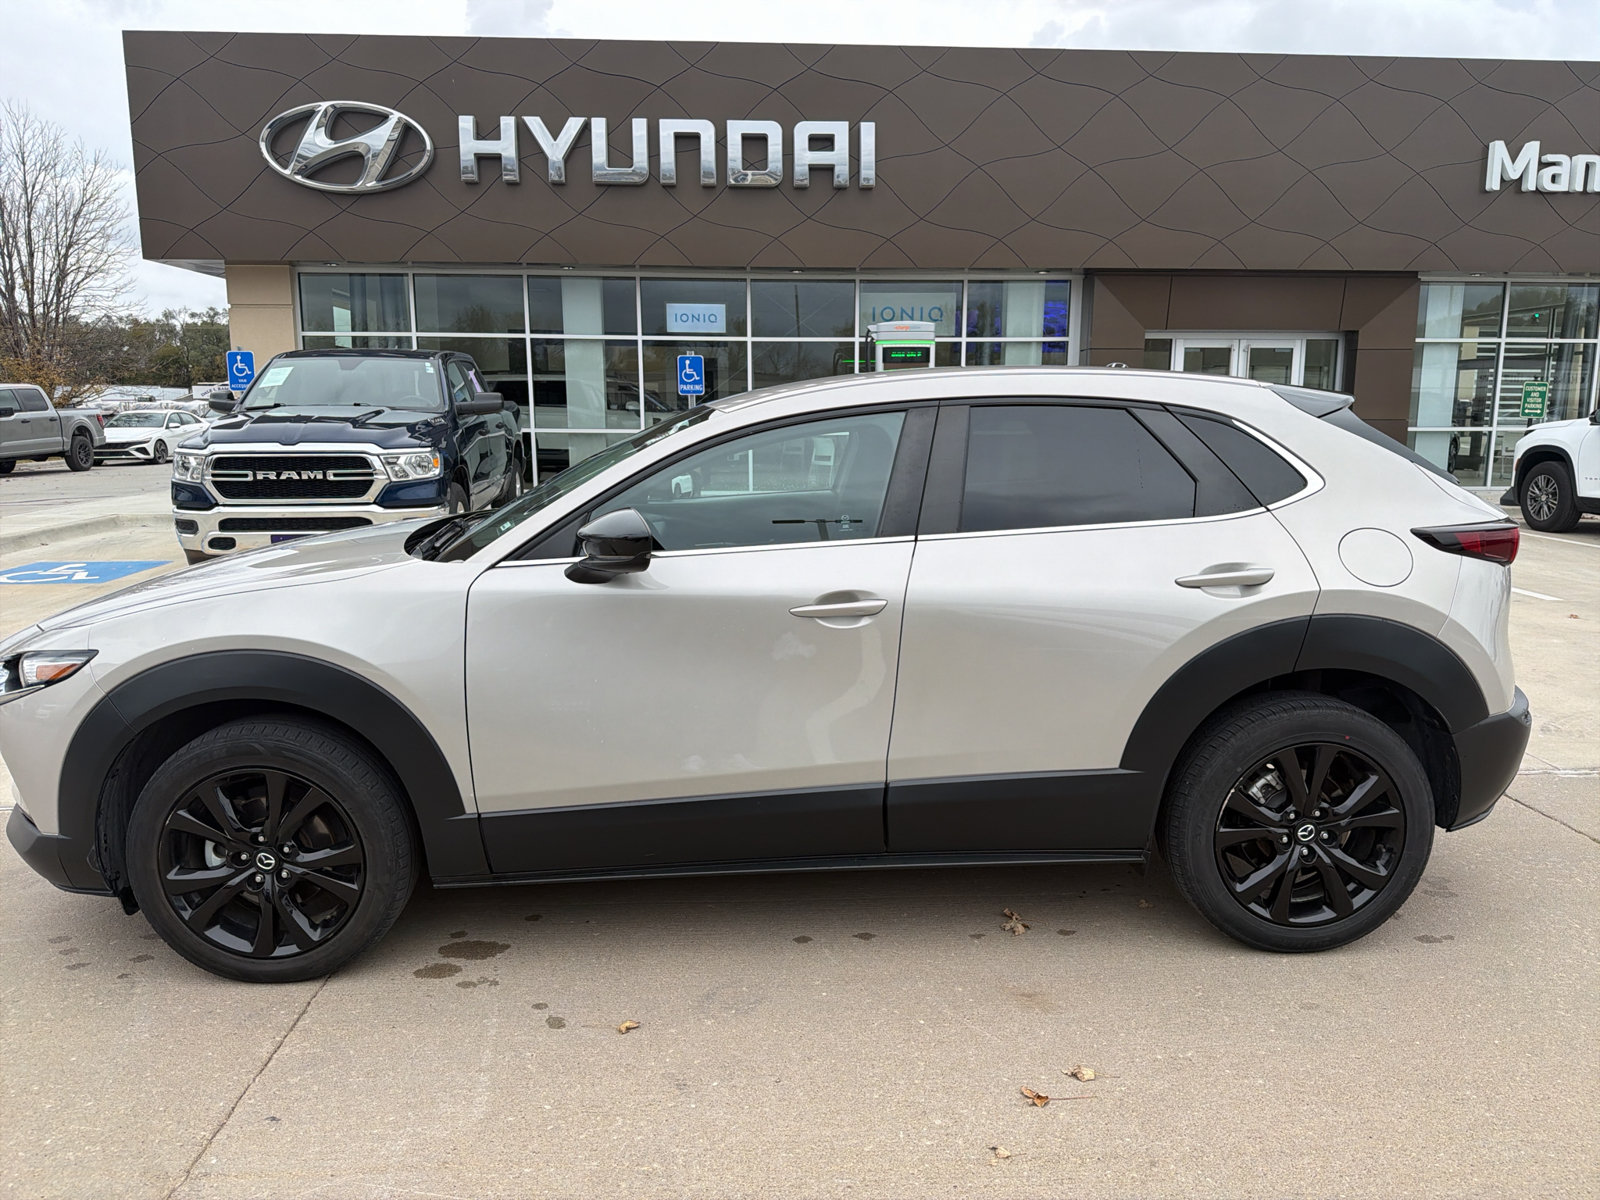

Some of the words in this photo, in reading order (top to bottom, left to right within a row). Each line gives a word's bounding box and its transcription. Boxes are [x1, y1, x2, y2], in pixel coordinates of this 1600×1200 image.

[458, 115, 877, 188] HYUNDAI
[1485, 140, 1600, 193] Man
[674, 313, 718, 323] IONIQ
[872, 305, 944, 322] IONIQ
[255, 470, 324, 480] RAM
